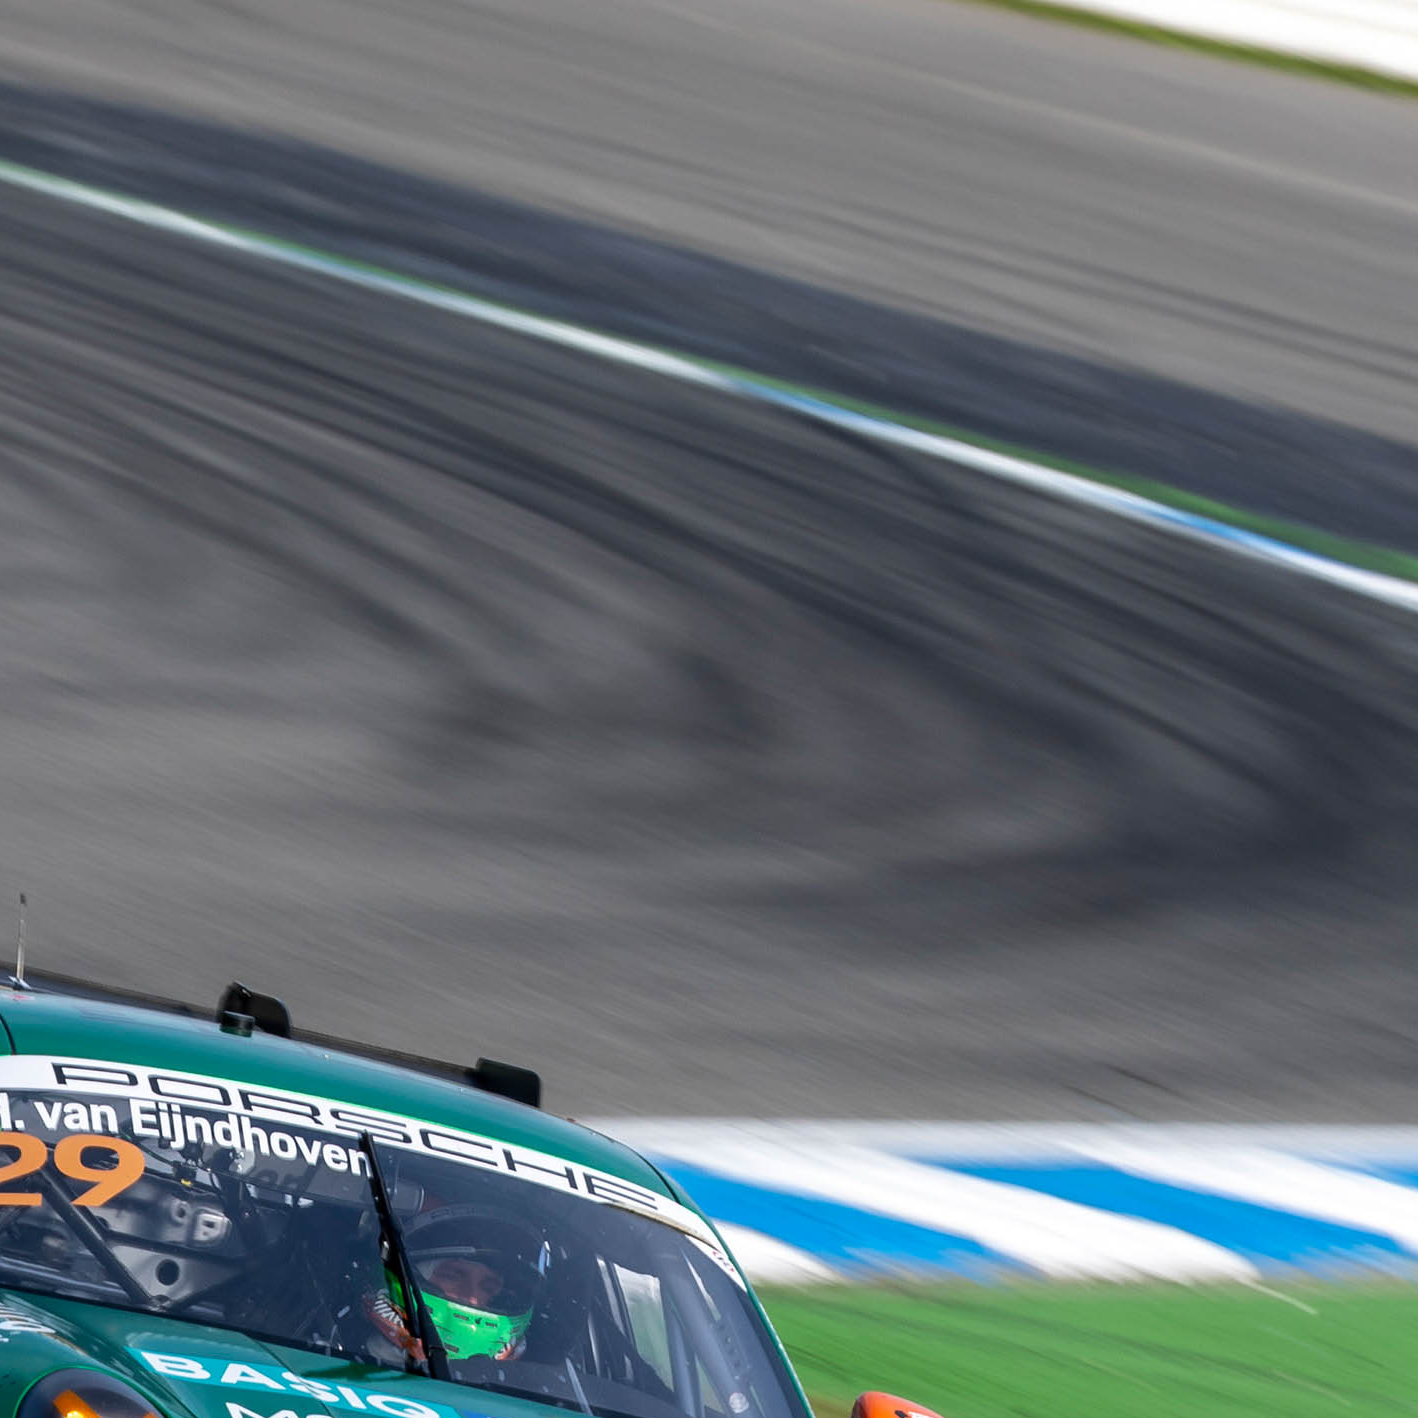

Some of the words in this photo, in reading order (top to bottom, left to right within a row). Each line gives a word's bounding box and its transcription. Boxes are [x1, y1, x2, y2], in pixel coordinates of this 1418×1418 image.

[34, 1099, 119, 1133] van
[130, 1097, 373, 1178] Eijndhoven
[51, 1061, 659, 1210] PORSCHE
